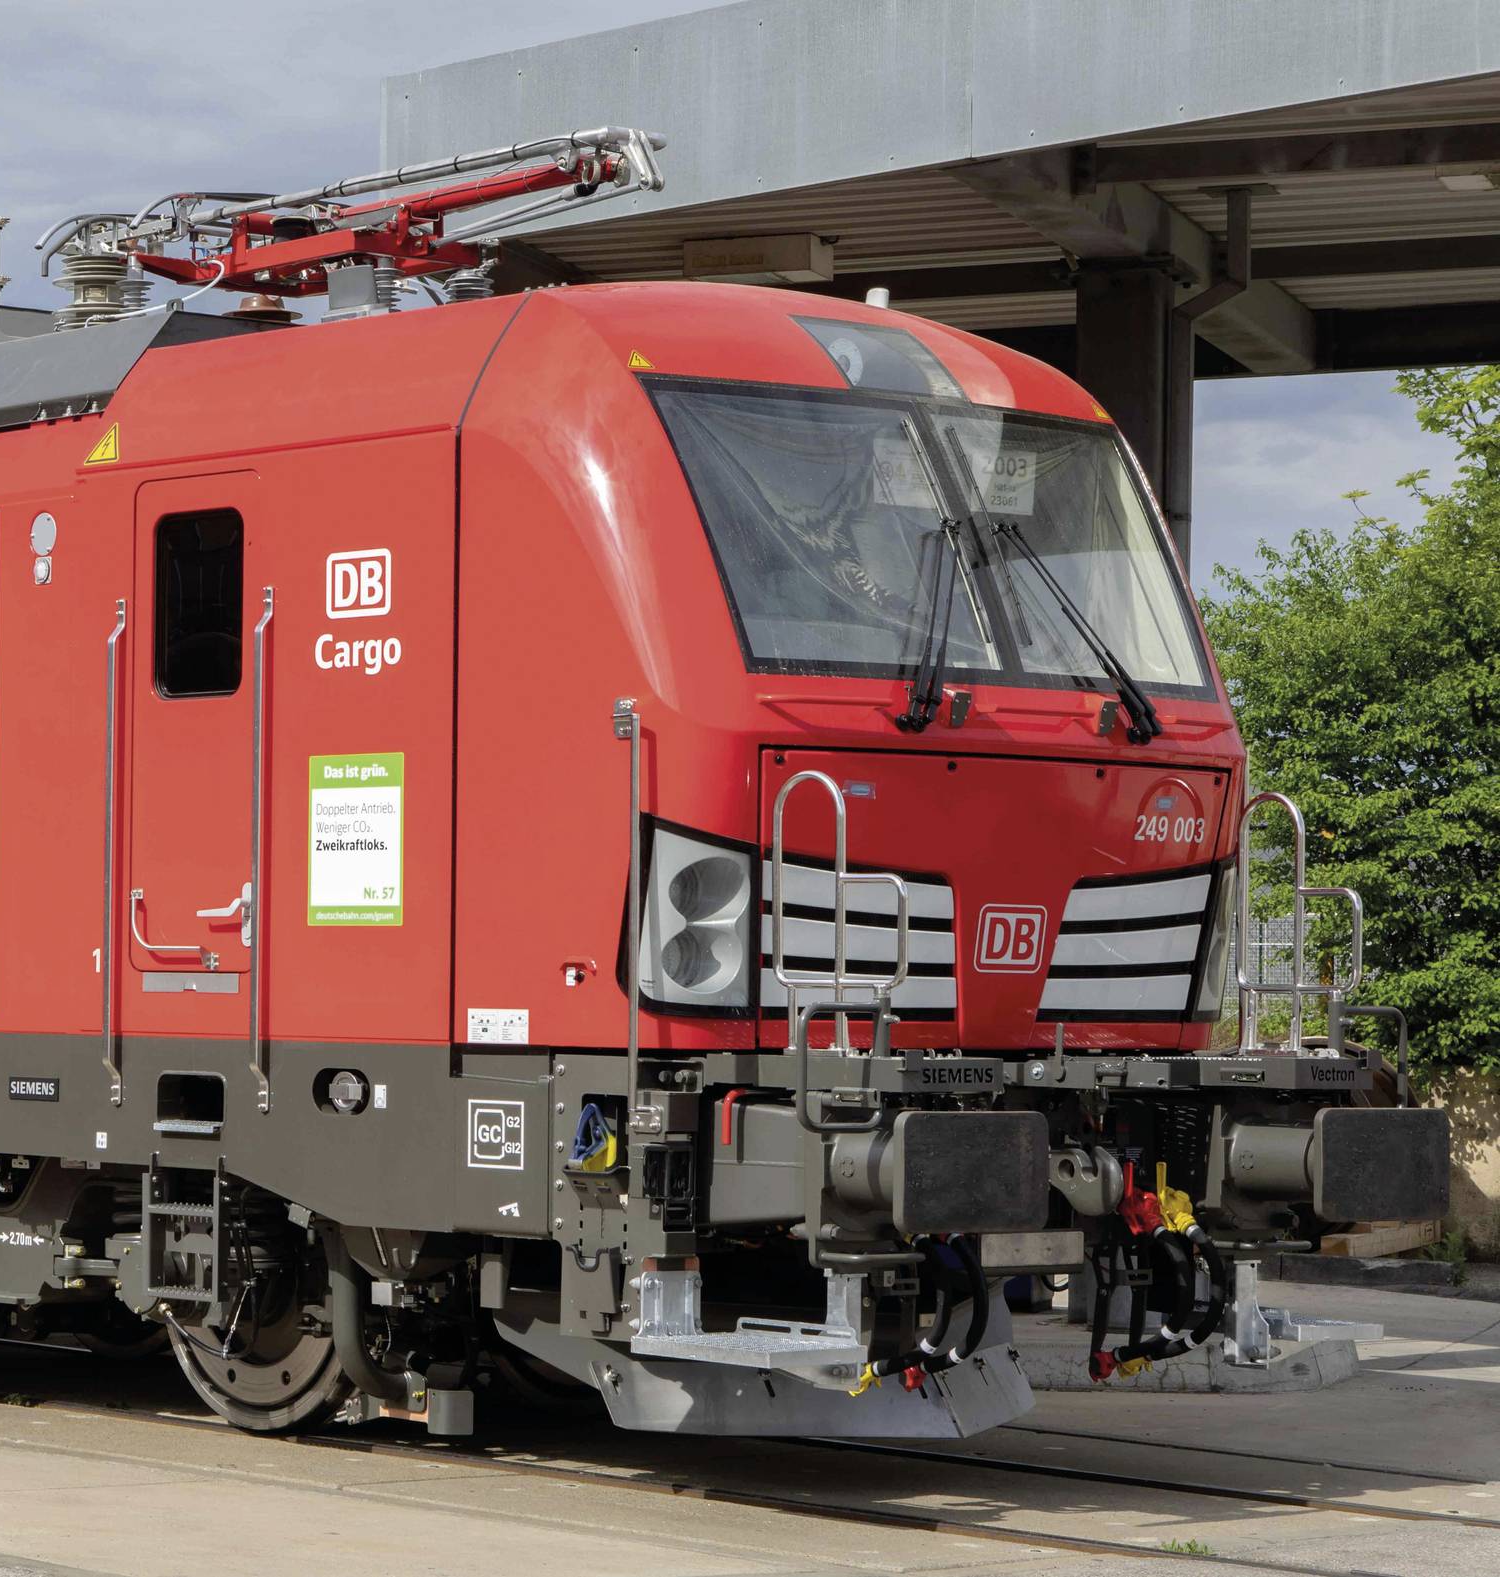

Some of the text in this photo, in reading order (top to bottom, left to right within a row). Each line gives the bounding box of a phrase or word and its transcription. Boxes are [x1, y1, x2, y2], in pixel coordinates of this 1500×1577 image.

[333, 560, 384, 608] DB
[314, 633, 402, 675] Cargo
[323, 764, 389, 781] Das ist grün.
[315, 801, 397, 818] Doppelter Antrieb.
[315, 822, 352, 836] Weniger
[1134, 815, 1205, 844] 249 003
[315, 839, 389, 852] Zweikraftloks.
[363, 887, 395, 900] Nr. 57
[985, 917, 1036, 961] DB
[92, 948, 101, 973] 1
[922, 1066, 994, 1085] SIEMENS
[1310, 1065, 1356, 1083] Vectron
[10, 1080, 55, 1096] SIEMENS
[506, 1116, 521, 1128] G2
[477, 1124, 502, 1143] GC
